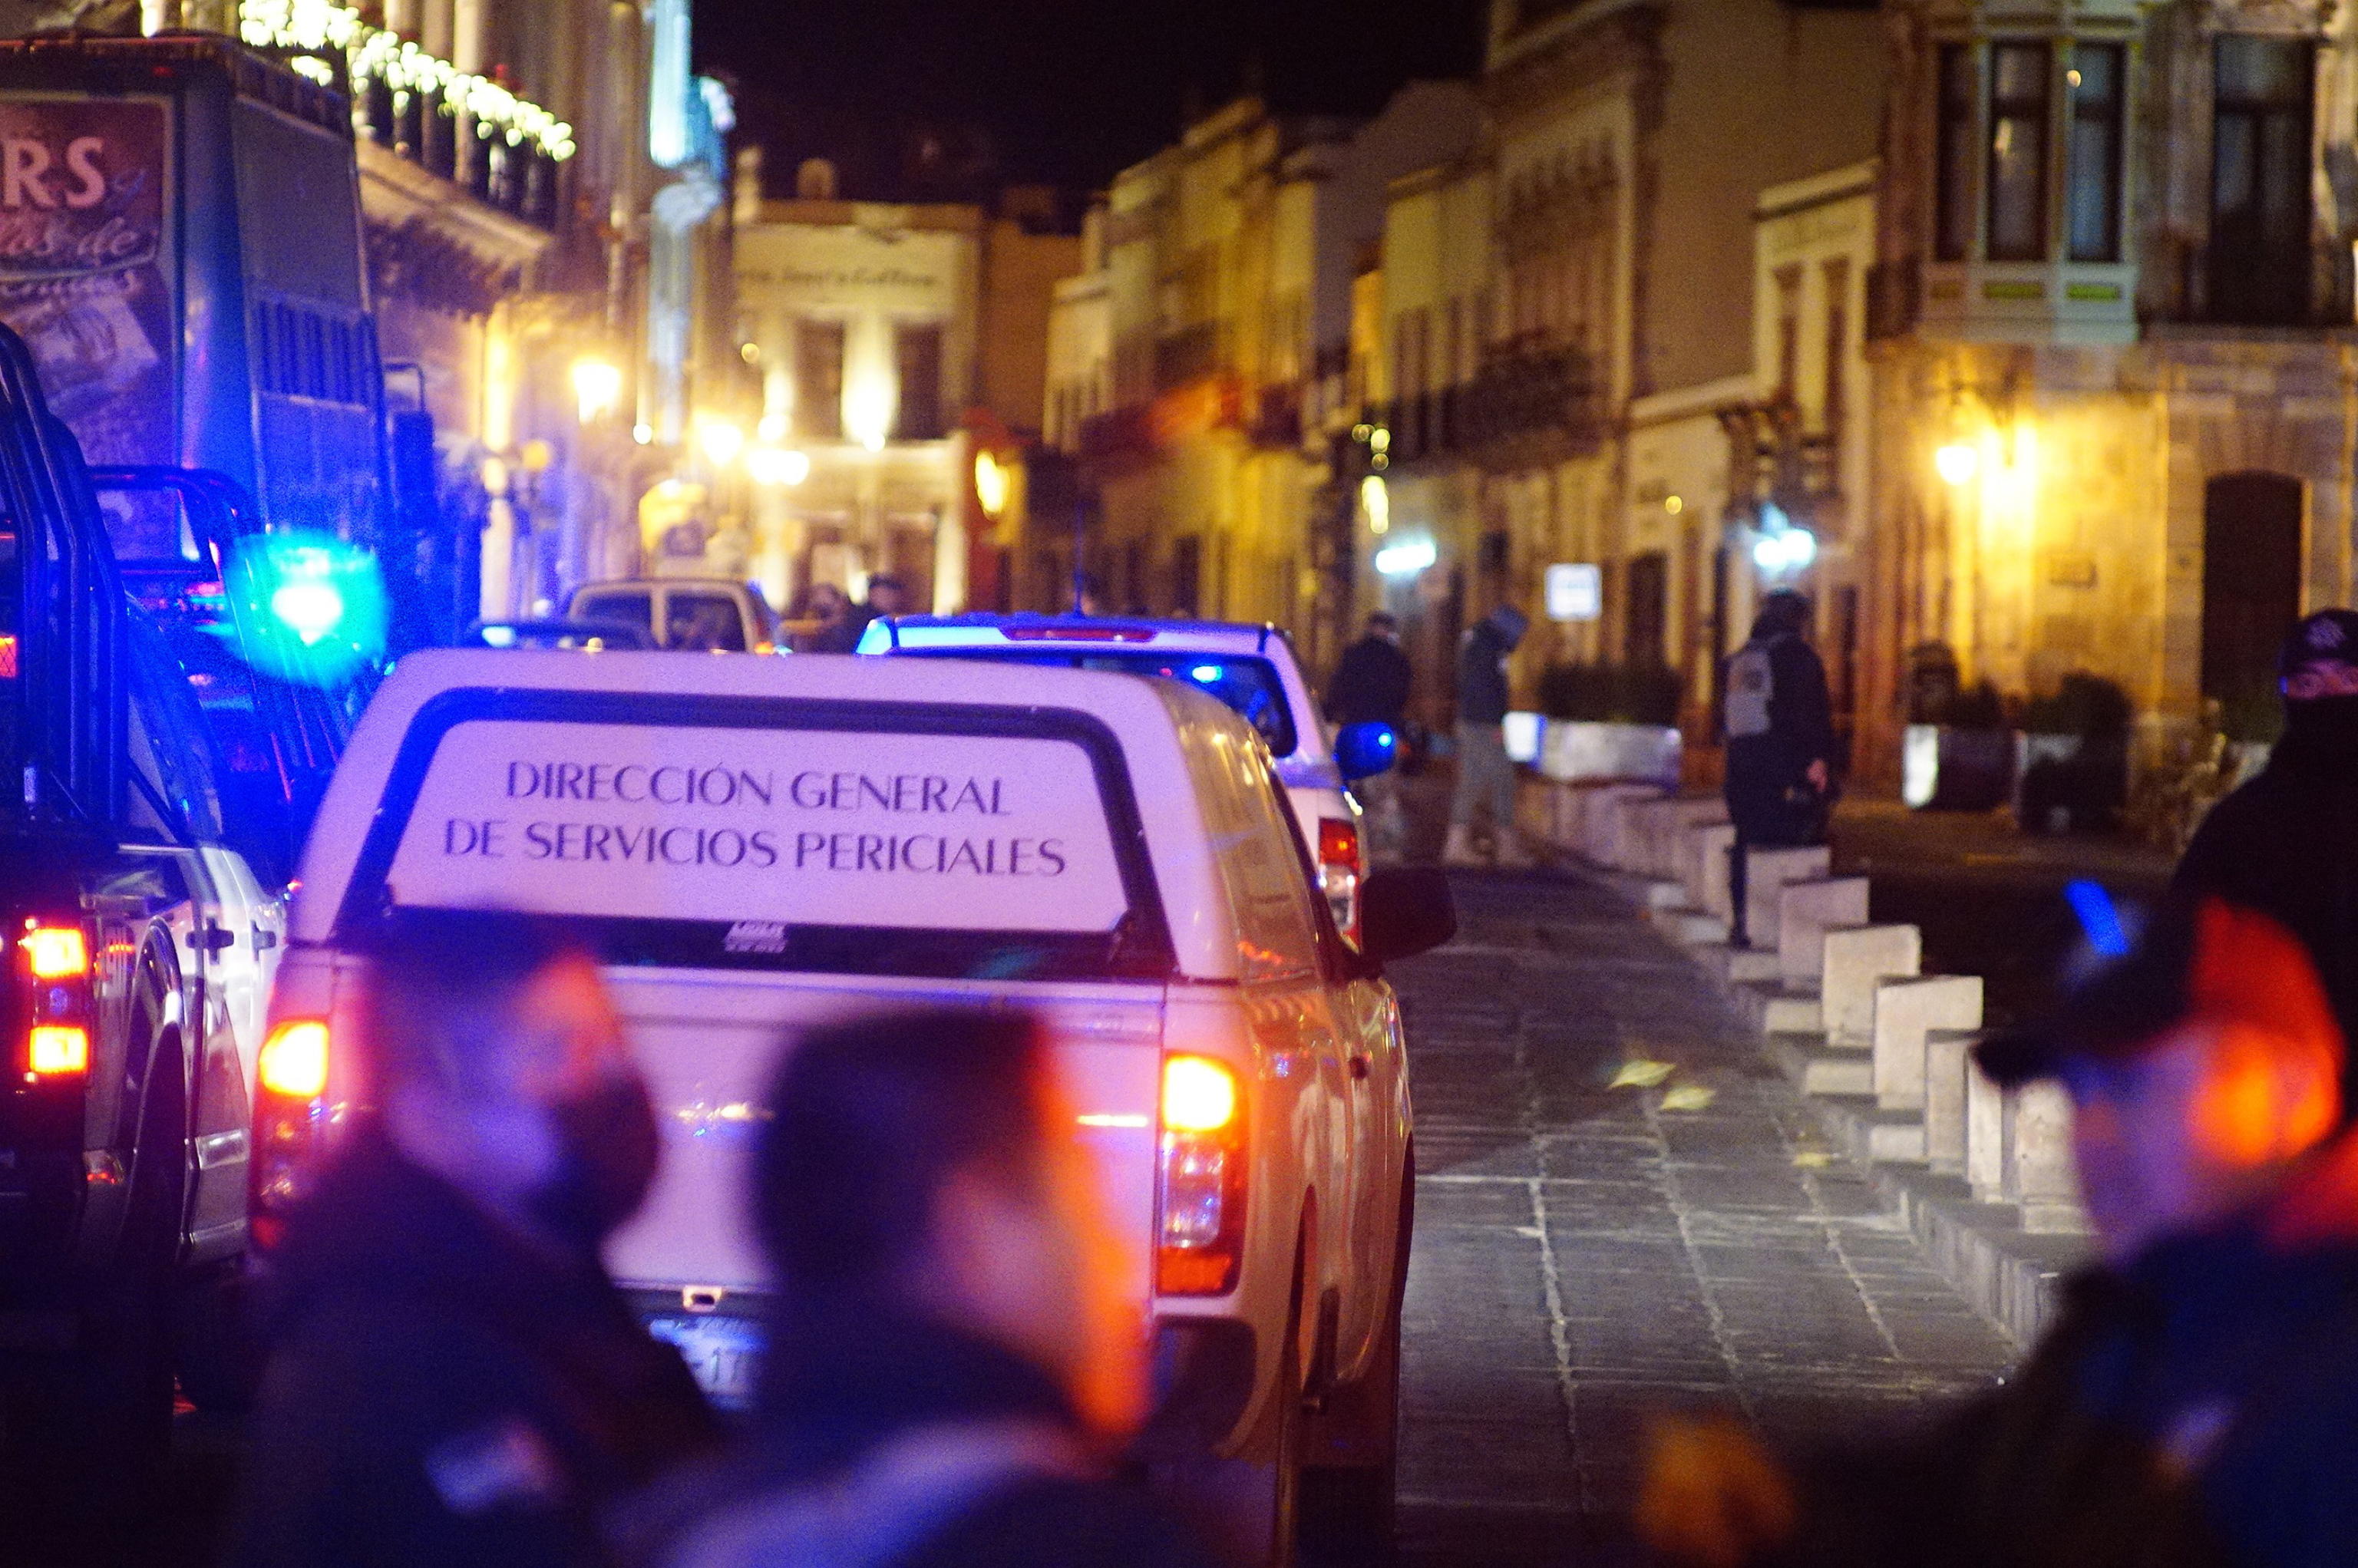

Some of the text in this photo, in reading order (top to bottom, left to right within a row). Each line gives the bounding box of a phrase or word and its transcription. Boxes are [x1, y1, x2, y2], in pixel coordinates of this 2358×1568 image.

[507, 761, 1012, 815] DIRECCIÓN GENERAL
[444, 818, 1065, 876] DE SERVICIOS PERICIALES
